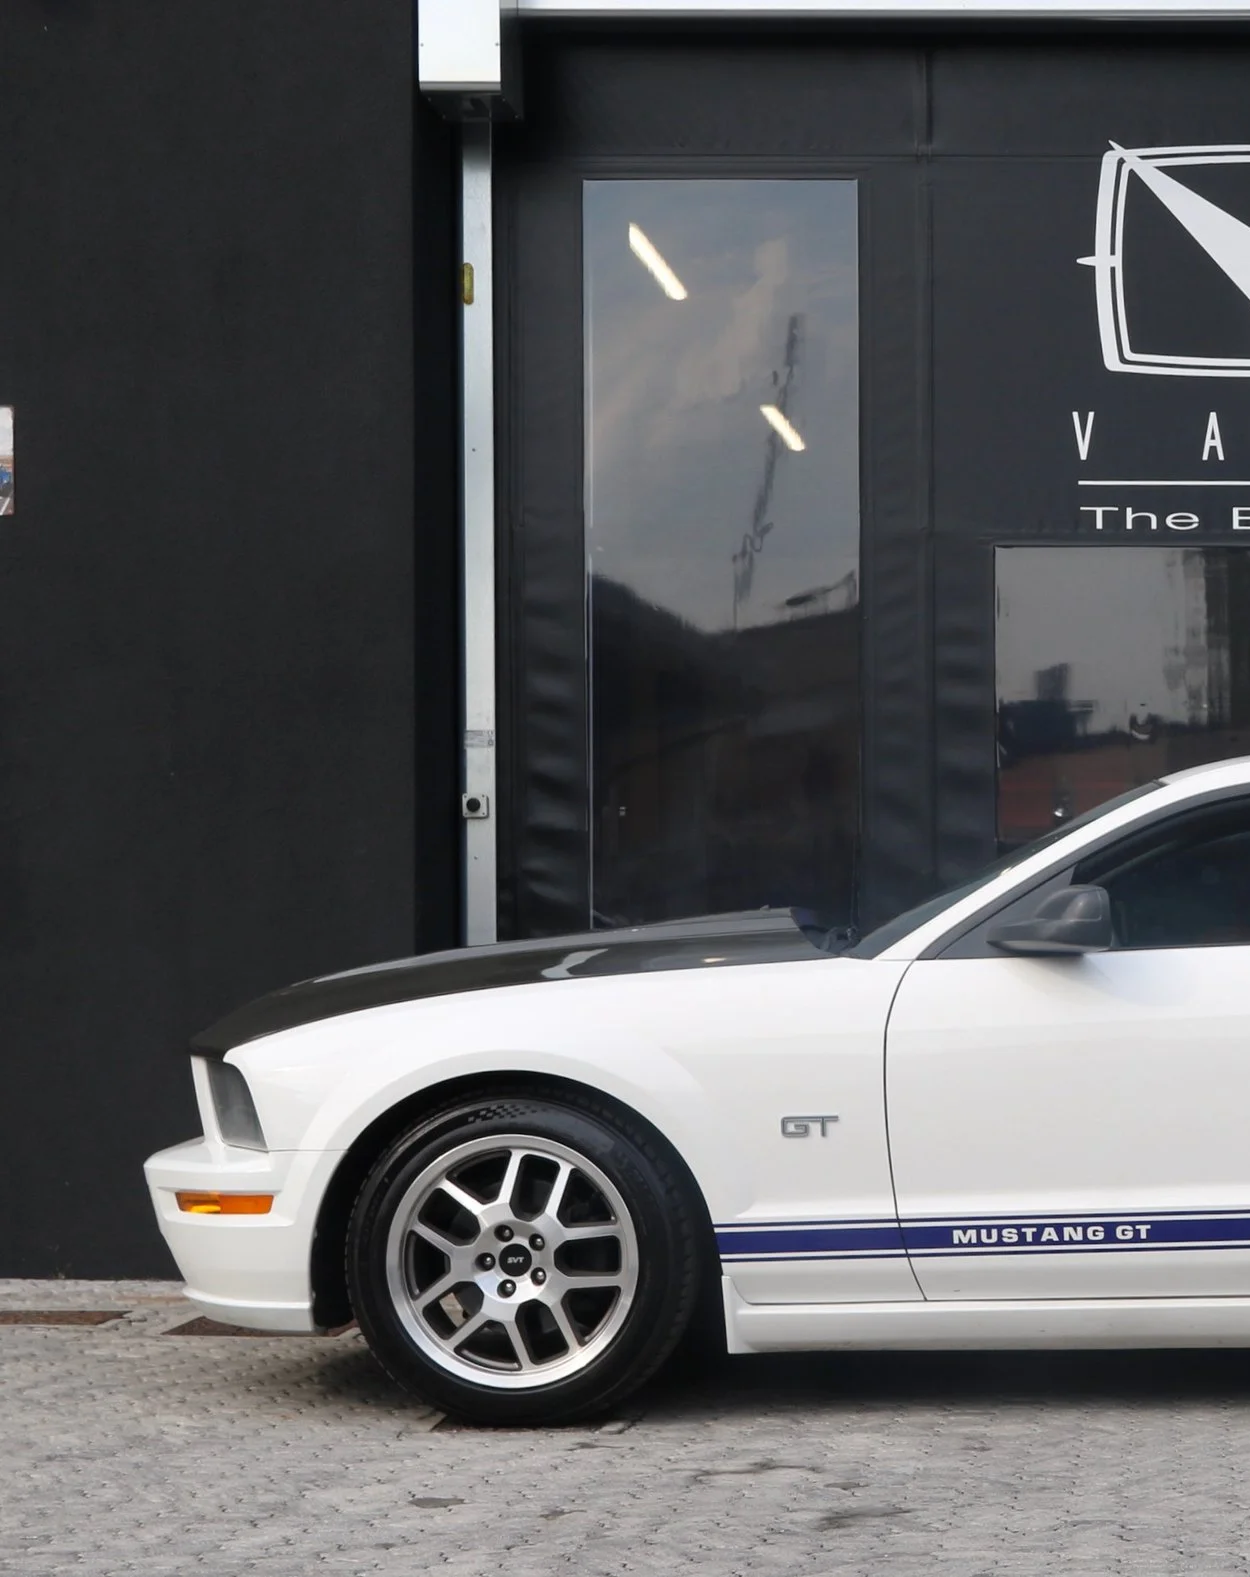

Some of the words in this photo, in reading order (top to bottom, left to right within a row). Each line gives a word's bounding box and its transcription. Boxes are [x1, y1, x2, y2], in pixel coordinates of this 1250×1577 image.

[1079, 506, 1200, 531] The
[780, 1114, 840, 1139] GT
[952, 1226, 1105, 1244] MUSTANG
[1115, 1224, 1152, 1241] GT
[507, 1256, 525, 1264] SVT
